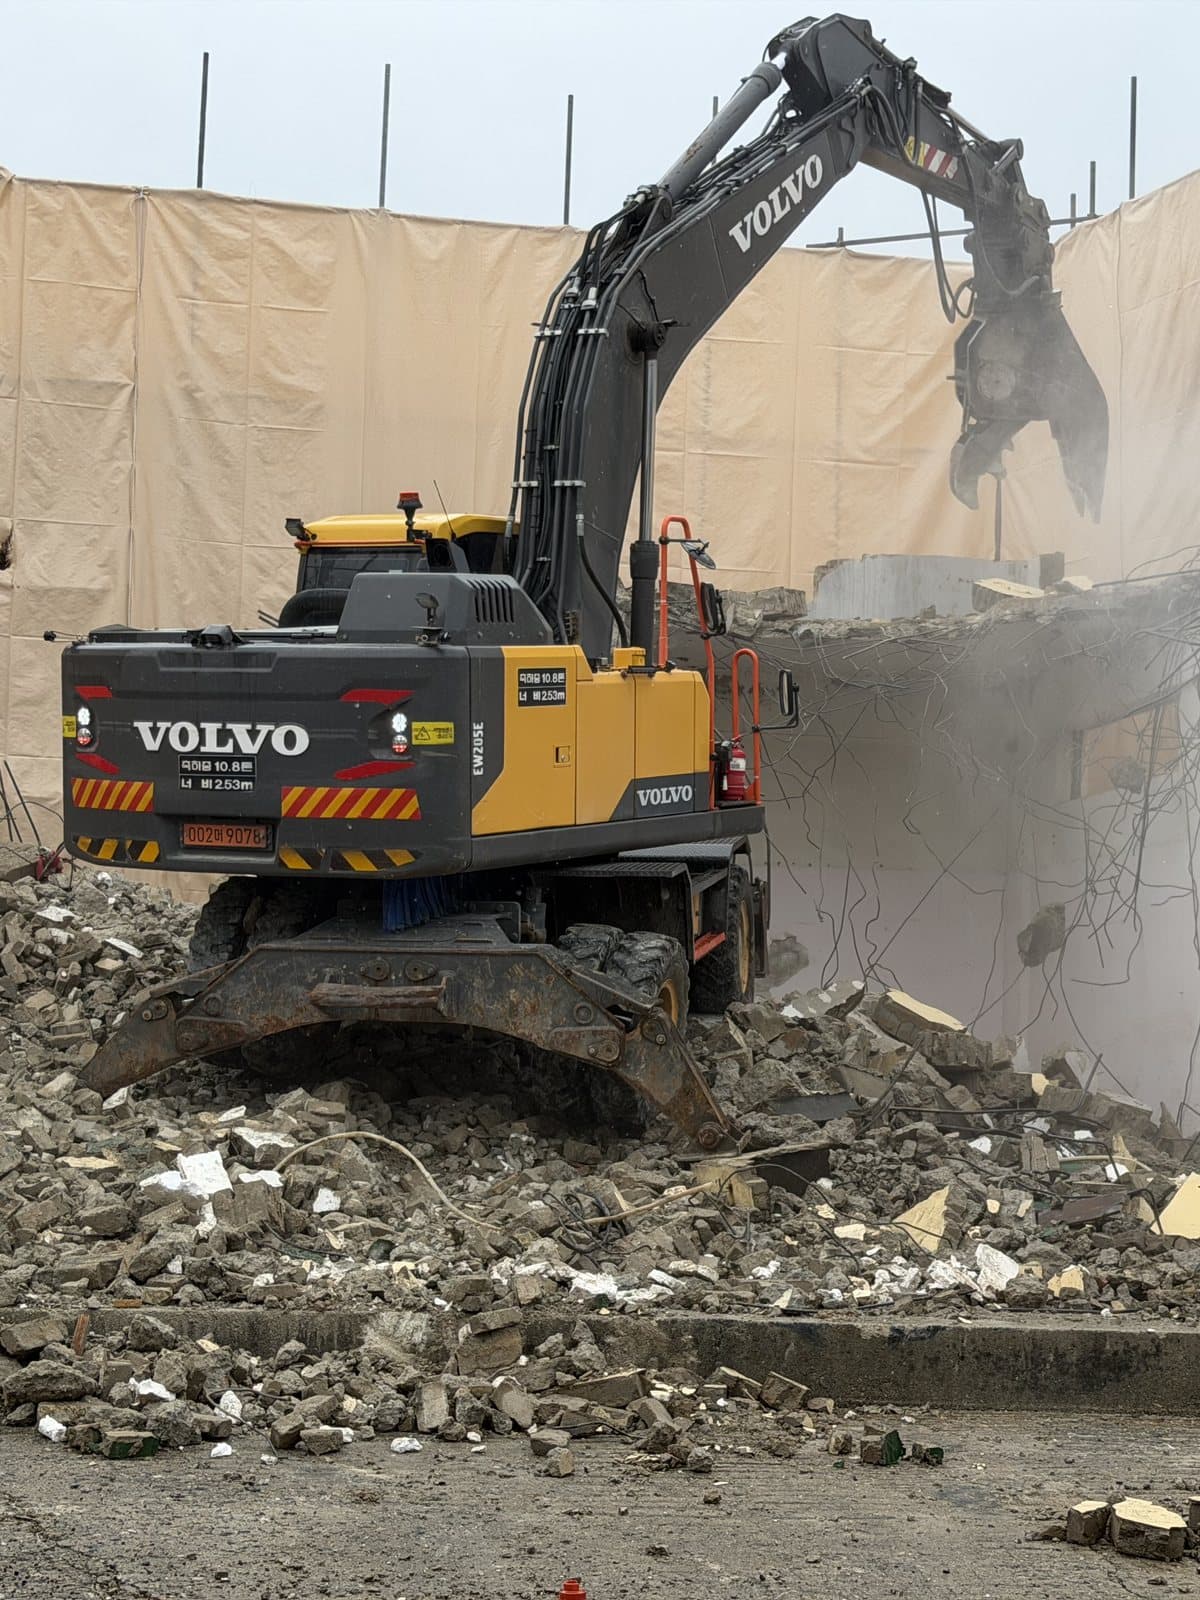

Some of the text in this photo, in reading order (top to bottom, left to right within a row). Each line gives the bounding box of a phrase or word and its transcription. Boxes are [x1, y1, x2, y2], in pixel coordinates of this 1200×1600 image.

[728, 154, 823, 253] VOLVO
[133, 721, 310, 756] VOLVO
[473, 722, 484, 776] EW205E
[636, 785, 693, 807] VOLVO
